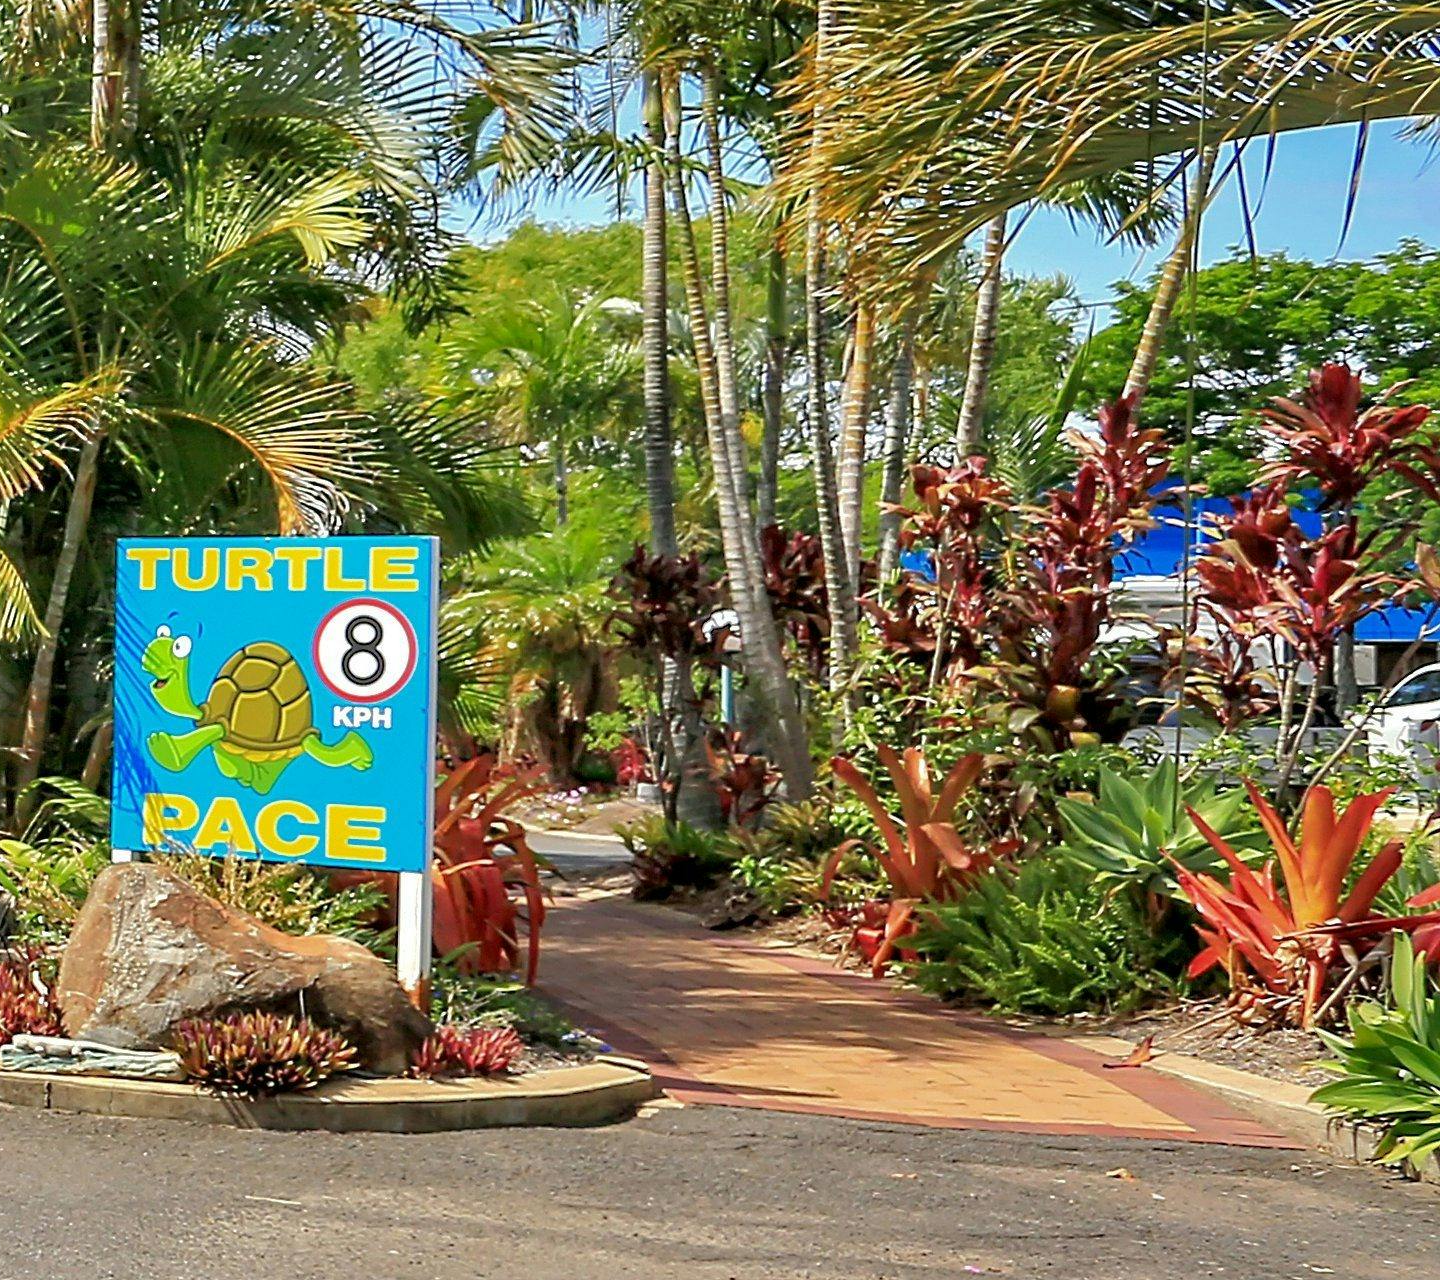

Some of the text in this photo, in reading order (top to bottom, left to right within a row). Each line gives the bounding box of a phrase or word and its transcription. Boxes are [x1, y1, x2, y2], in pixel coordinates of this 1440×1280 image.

[126, 547, 419, 592] TURTLE
[341, 614, 385, 686] 8
[332, 705, 393, 729] KPH
[141, 793, 387, 863] PACE
